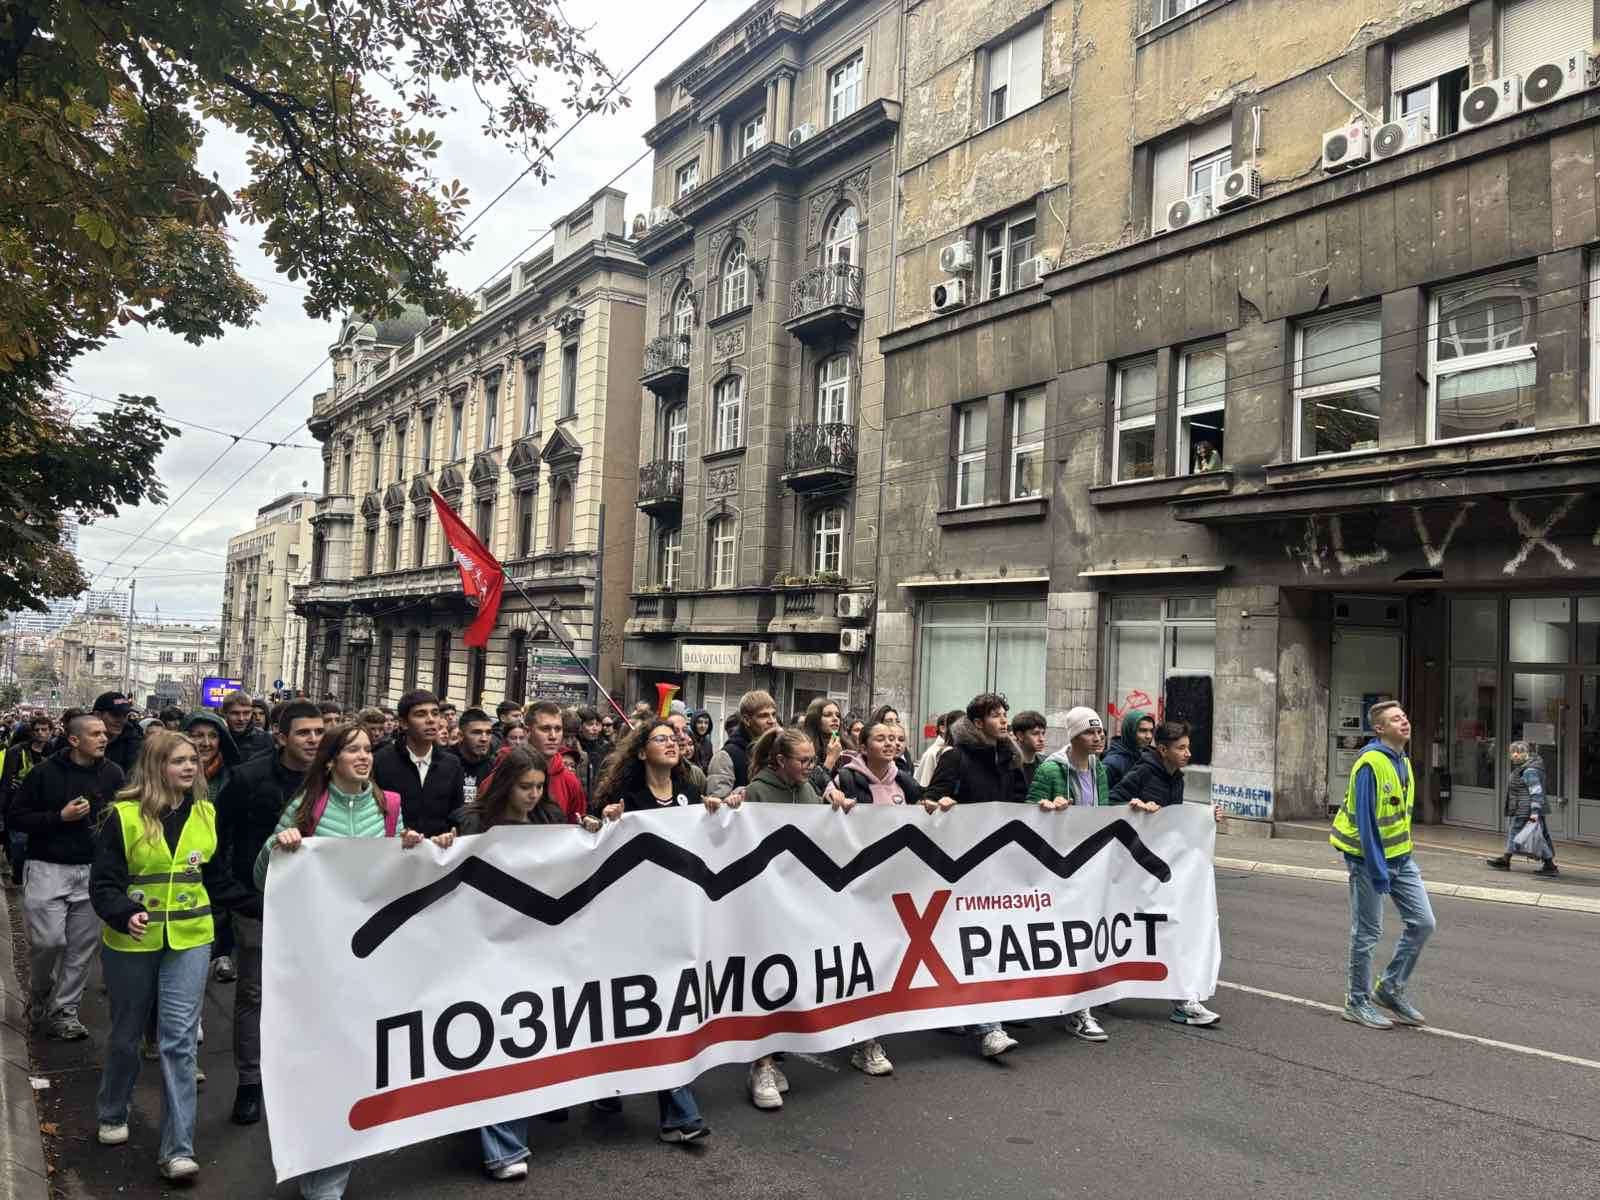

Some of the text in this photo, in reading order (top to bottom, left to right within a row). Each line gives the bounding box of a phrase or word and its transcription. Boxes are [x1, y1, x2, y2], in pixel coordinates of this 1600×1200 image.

[956, 890, 1051, 911] гимназија
[376, 890, 1168, 1089] ПОЗИВАМО НА ХРАБРОСТ
